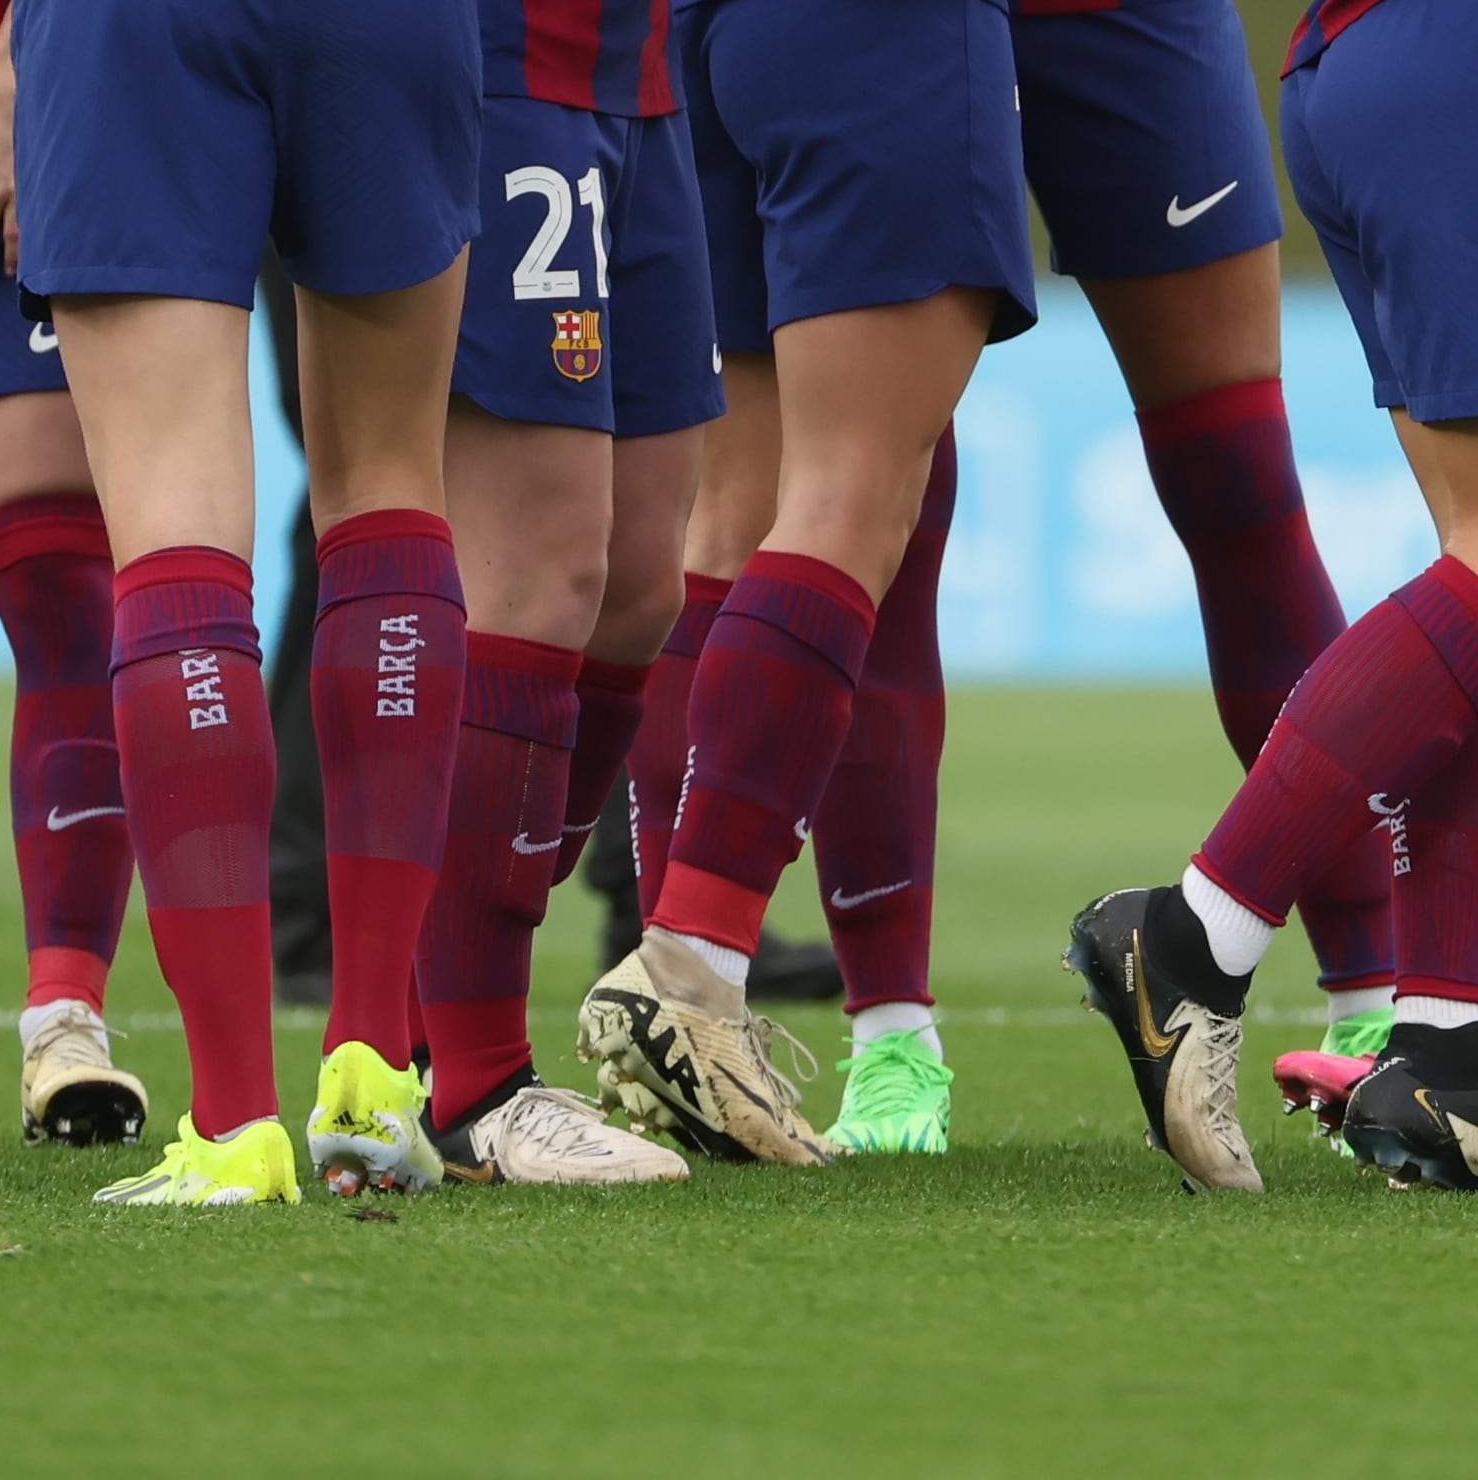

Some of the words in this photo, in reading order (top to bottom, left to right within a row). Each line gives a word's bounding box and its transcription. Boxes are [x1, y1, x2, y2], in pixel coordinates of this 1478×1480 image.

[505, 165, 610, 300] 21
[178, 648, 228, 730] BAR
[376, 614, 426, 717] BARÇA
[1125, 952, 1135, 993] MEDINA
